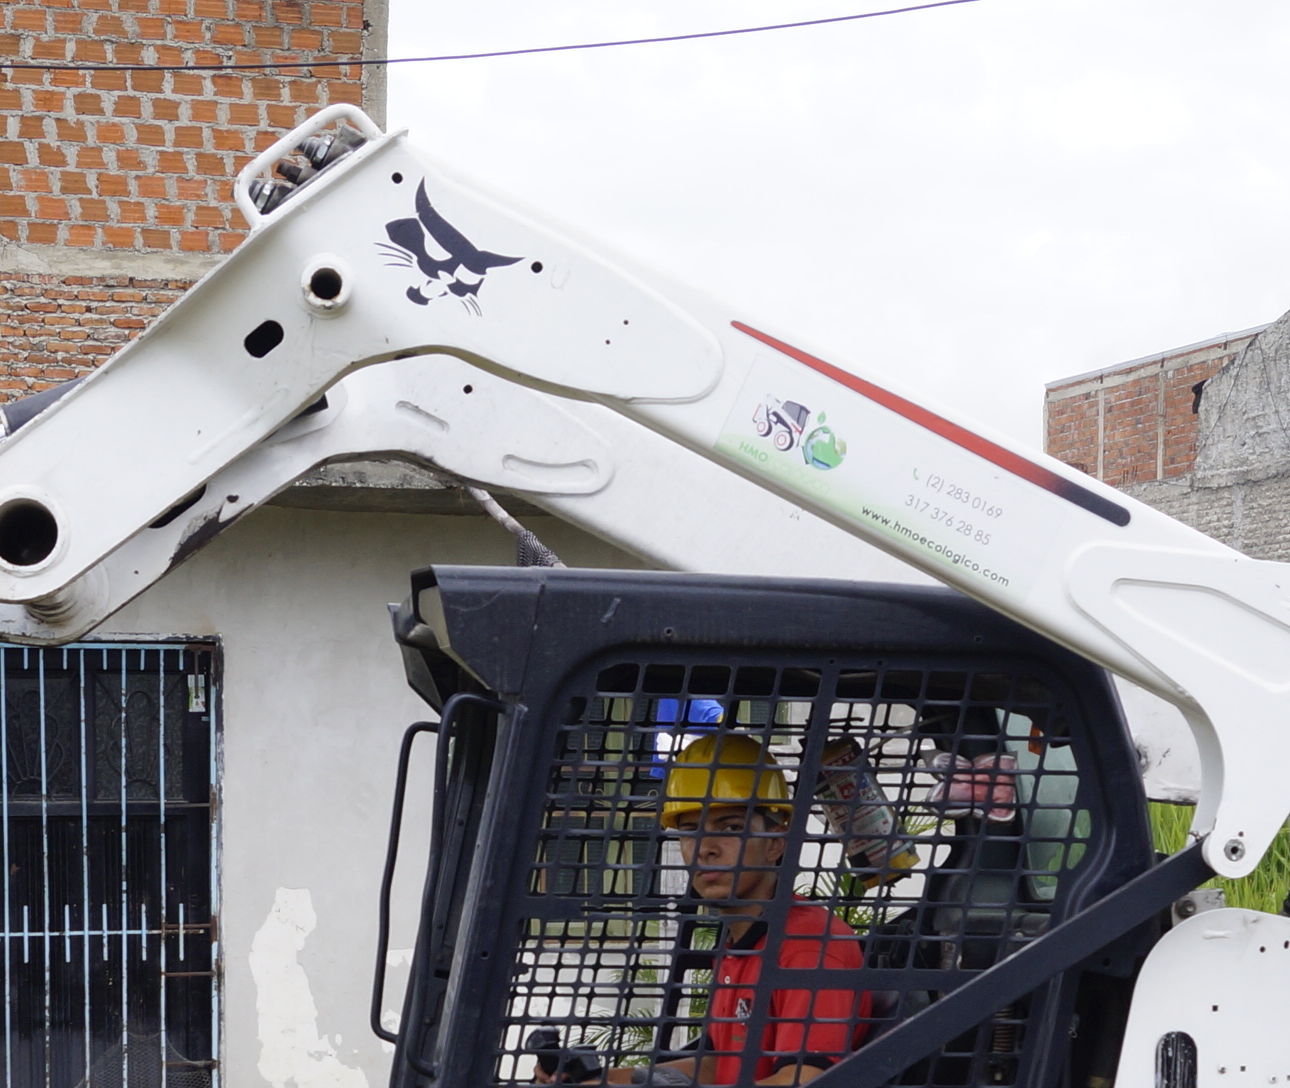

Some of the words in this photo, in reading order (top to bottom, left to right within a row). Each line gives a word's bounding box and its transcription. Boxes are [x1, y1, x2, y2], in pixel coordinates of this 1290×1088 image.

[904, 494, 930, 513] 317
[930, 507, 955, 527] 376
[956, 520, 973, 536] 28
[974, 530, 992, 546] 85
[926, 474, 945, 493] (2)
[946, 484, 971, 504] 283
[971, 497, 1003, 519] 0169
[861, 506, 1010, 587] www.hmoecologico.com
